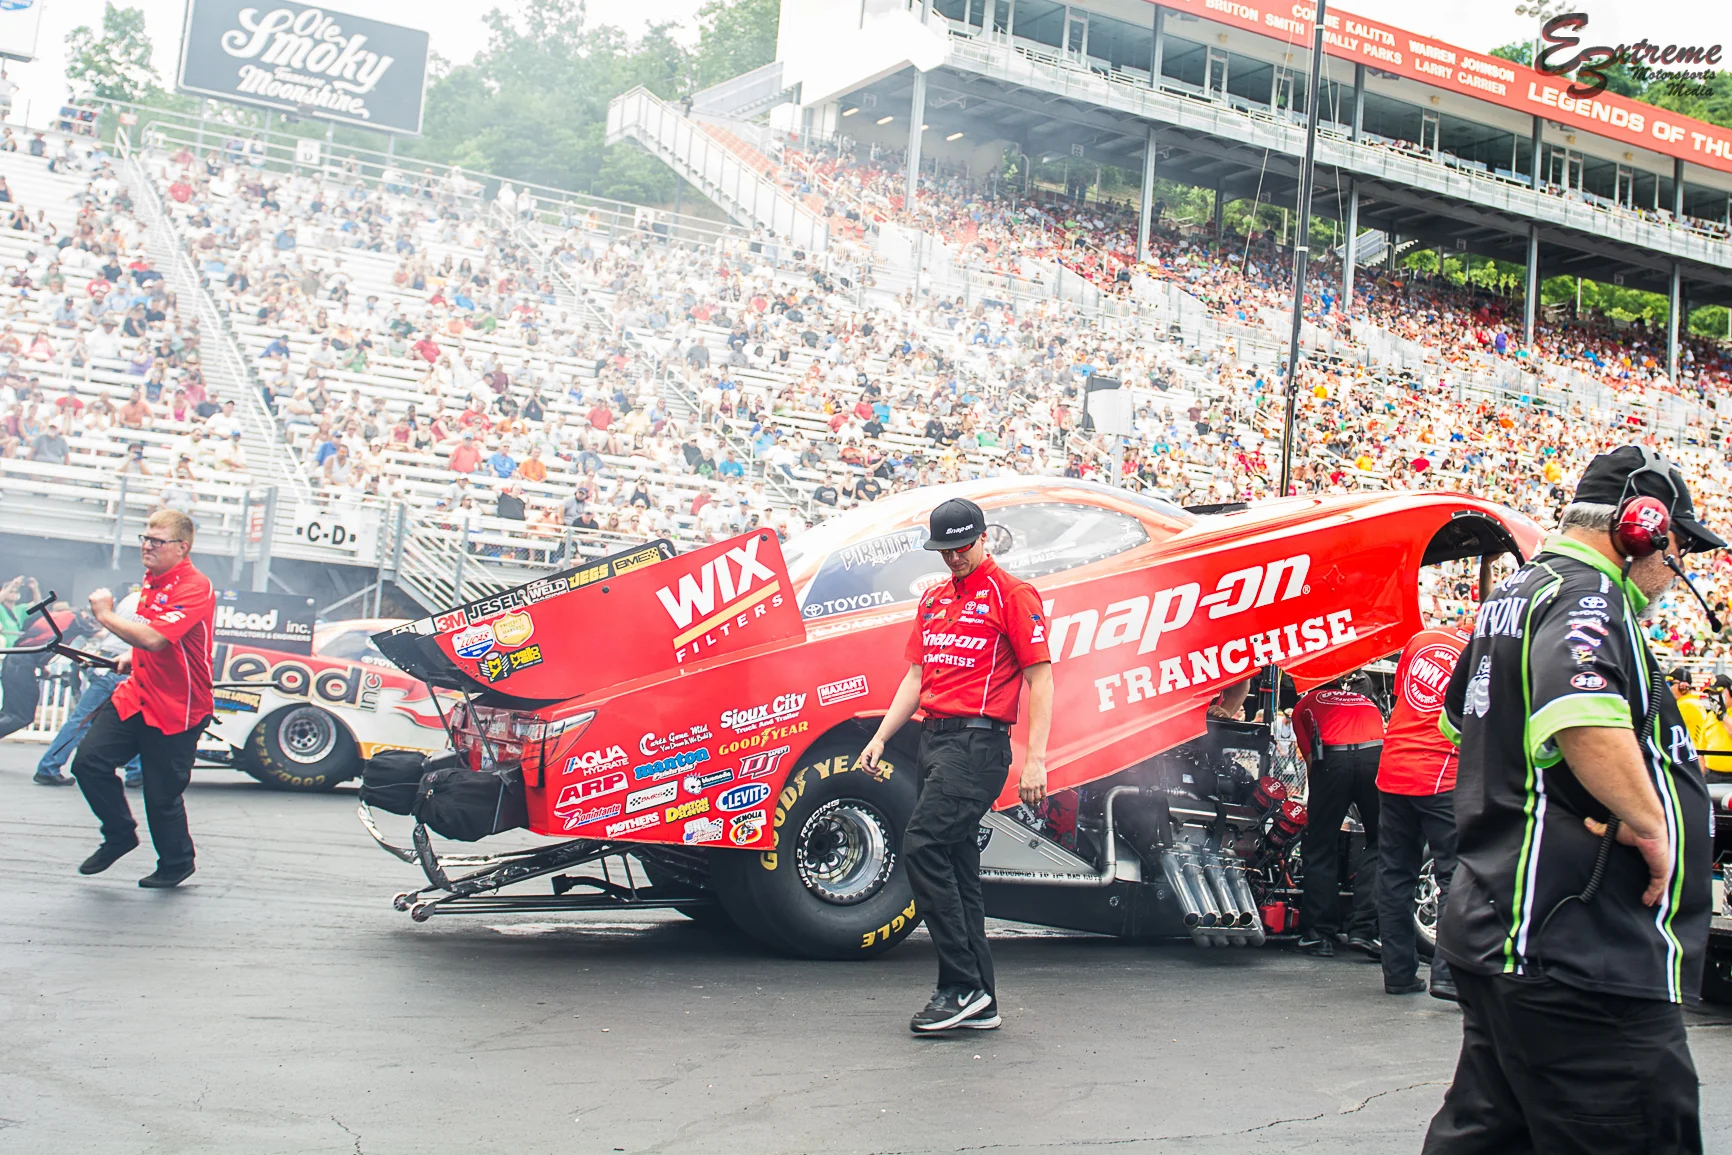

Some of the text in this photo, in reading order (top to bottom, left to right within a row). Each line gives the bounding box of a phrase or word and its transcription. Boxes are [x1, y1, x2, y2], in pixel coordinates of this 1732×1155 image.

[293, 8, 348, 48] Ole
[1205, 0, 1305, 35] BRUTON SMITH
[1345, 20, 1396, 46] KALITTA
[221, 7, 395, 94] Smoky
[1363, 42, 1402, 65] PARKS
[1408, 40, 1515, 83] WARREN JOHNSON
[236, 64, 371, 119] Moonshine
[1415, 58, 1506, 96] LARRY CARRIER
[1527, 82, 1645, 133] LEGENDS
[1652, 120, 1686, 143] OF
[945, 524, 973, 534] Snap-on
[437, 612, 466, 631] 3M
[470, 594, 521, 620] JESEL
[530, 580, 566, 600] WELD
[568, 563, 609, 588] JEGS
[655, 534, 776, 629] WIX
[824, 590, 895, 614] TOYOTA
[215, 604, 312, 635] Head inc.
[675, 594, 784, 663] FILTERS
[272, 634, 312, 642] ENGINEERS
[461, 631, 490, 648] LUCAS
[922, 629, 988, 651] Snap-on
[1094, 608, 1357, 713] FRANCHISE
[1411, 657, 1444, 688] OWN
[360, 673, 382, 712] inc
[821, 678, 863, 697] MAXANT
[1410, 683, 1437, 704] FRANCHISE
[721, 703, 768, 729] Sioux
[773, 693, 806, 714] City
[735, 712, 799, 734] Truck And Trailer
[690, 724, 708, 735] Wild
[571, 745, 628, 772] AQUA
[583, 757, 629, 776] HYDRATE
[634, 748, 710, 779] manton
[557, 772, 628, 808] ARP
[1267, 781, 1281, 793] MSD
[606, 812, 660, 834] MOTHERS
[733, 811, 762, 825] VENOLIA
[801, 799, 840, 838] RACING
[1290, 805, 1303, 818] MSD
[796, 848, 813, 888] WELD
